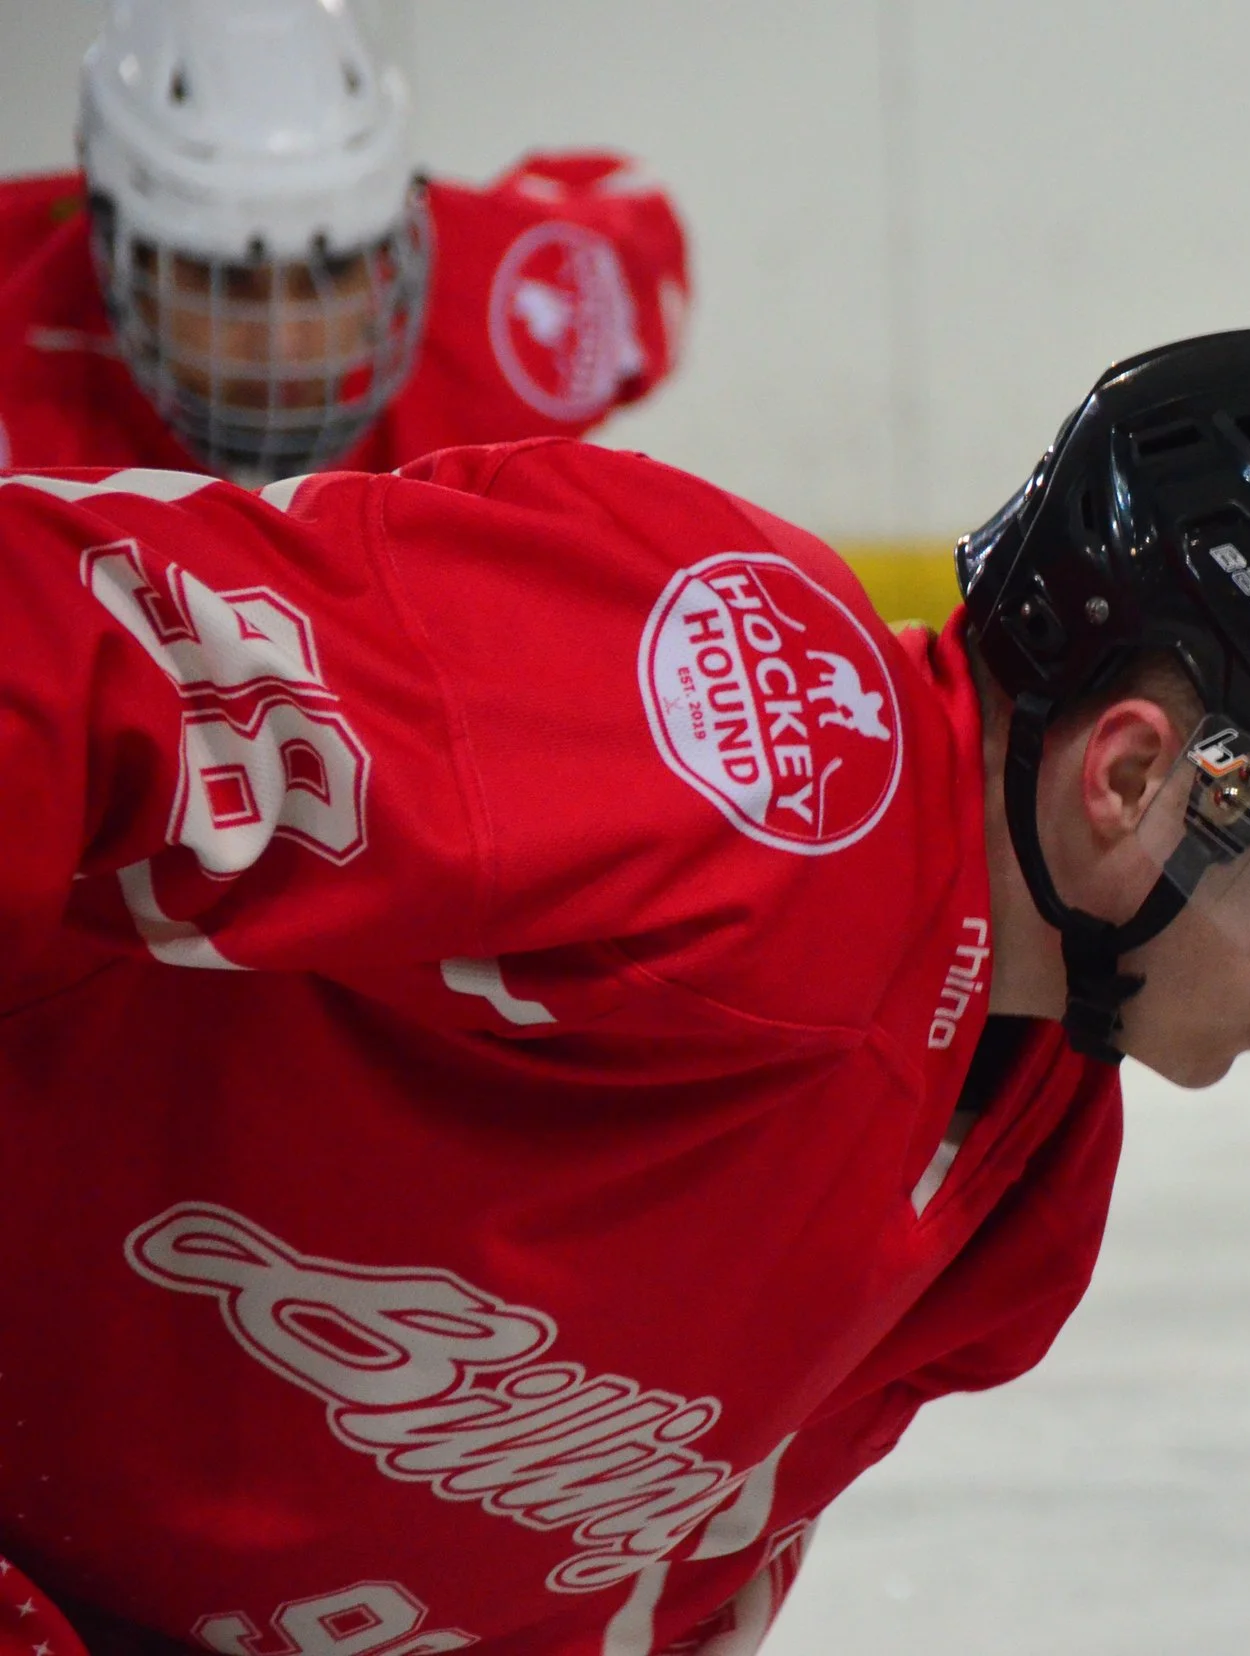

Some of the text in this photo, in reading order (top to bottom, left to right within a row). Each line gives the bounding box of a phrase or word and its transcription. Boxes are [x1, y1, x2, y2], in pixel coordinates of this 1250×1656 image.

[677, 666, 707, 740] EST. 2019
[683, 607, 760, 786] HOUND
[709, 573, 814, 825] HOCKEY
[927, 916, 990, 1050] rhino
